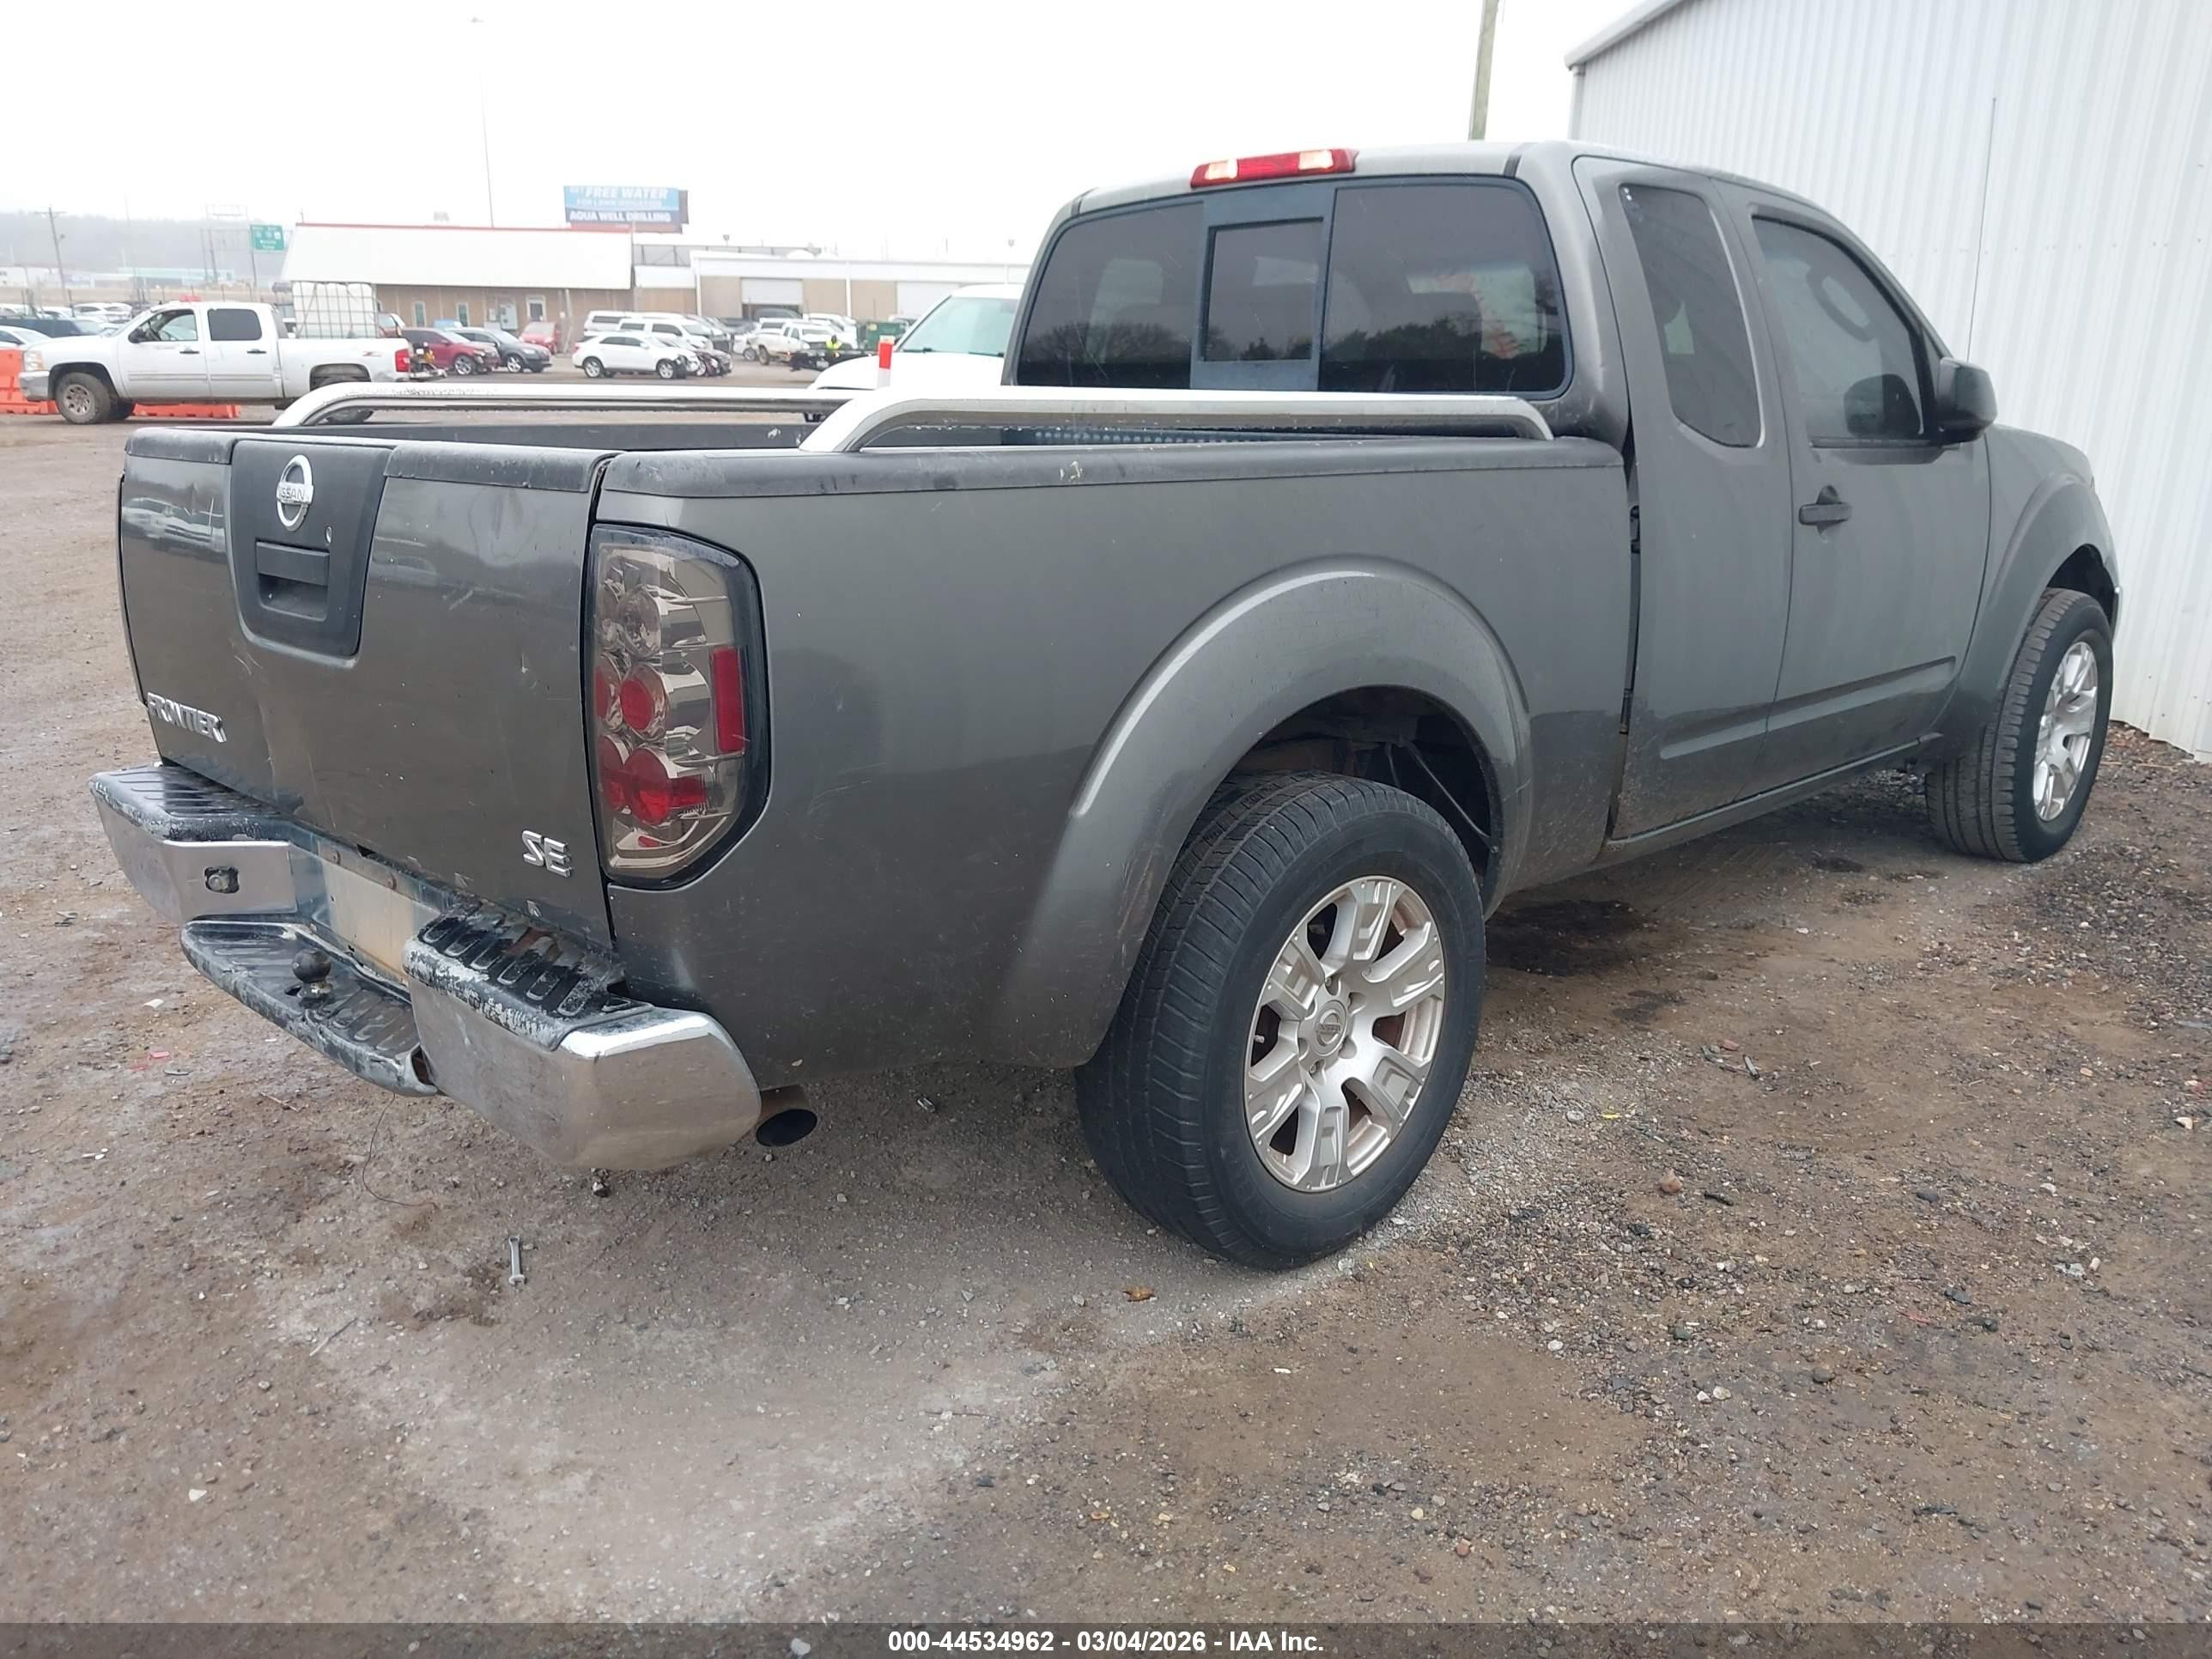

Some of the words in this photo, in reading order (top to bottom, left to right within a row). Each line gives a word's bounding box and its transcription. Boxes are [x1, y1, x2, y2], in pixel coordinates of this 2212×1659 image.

[585, 186, 619, 198] FREE
[622, 186, 668, 199] WATER
[569, 211, 598, 221] AQUA
[599, 212, 625, 222] WELL
[626, 212, 672, 222] DRILLING
[147, 691, 228, 743] FRONTIER
[521, 830, 571, 878] SE
